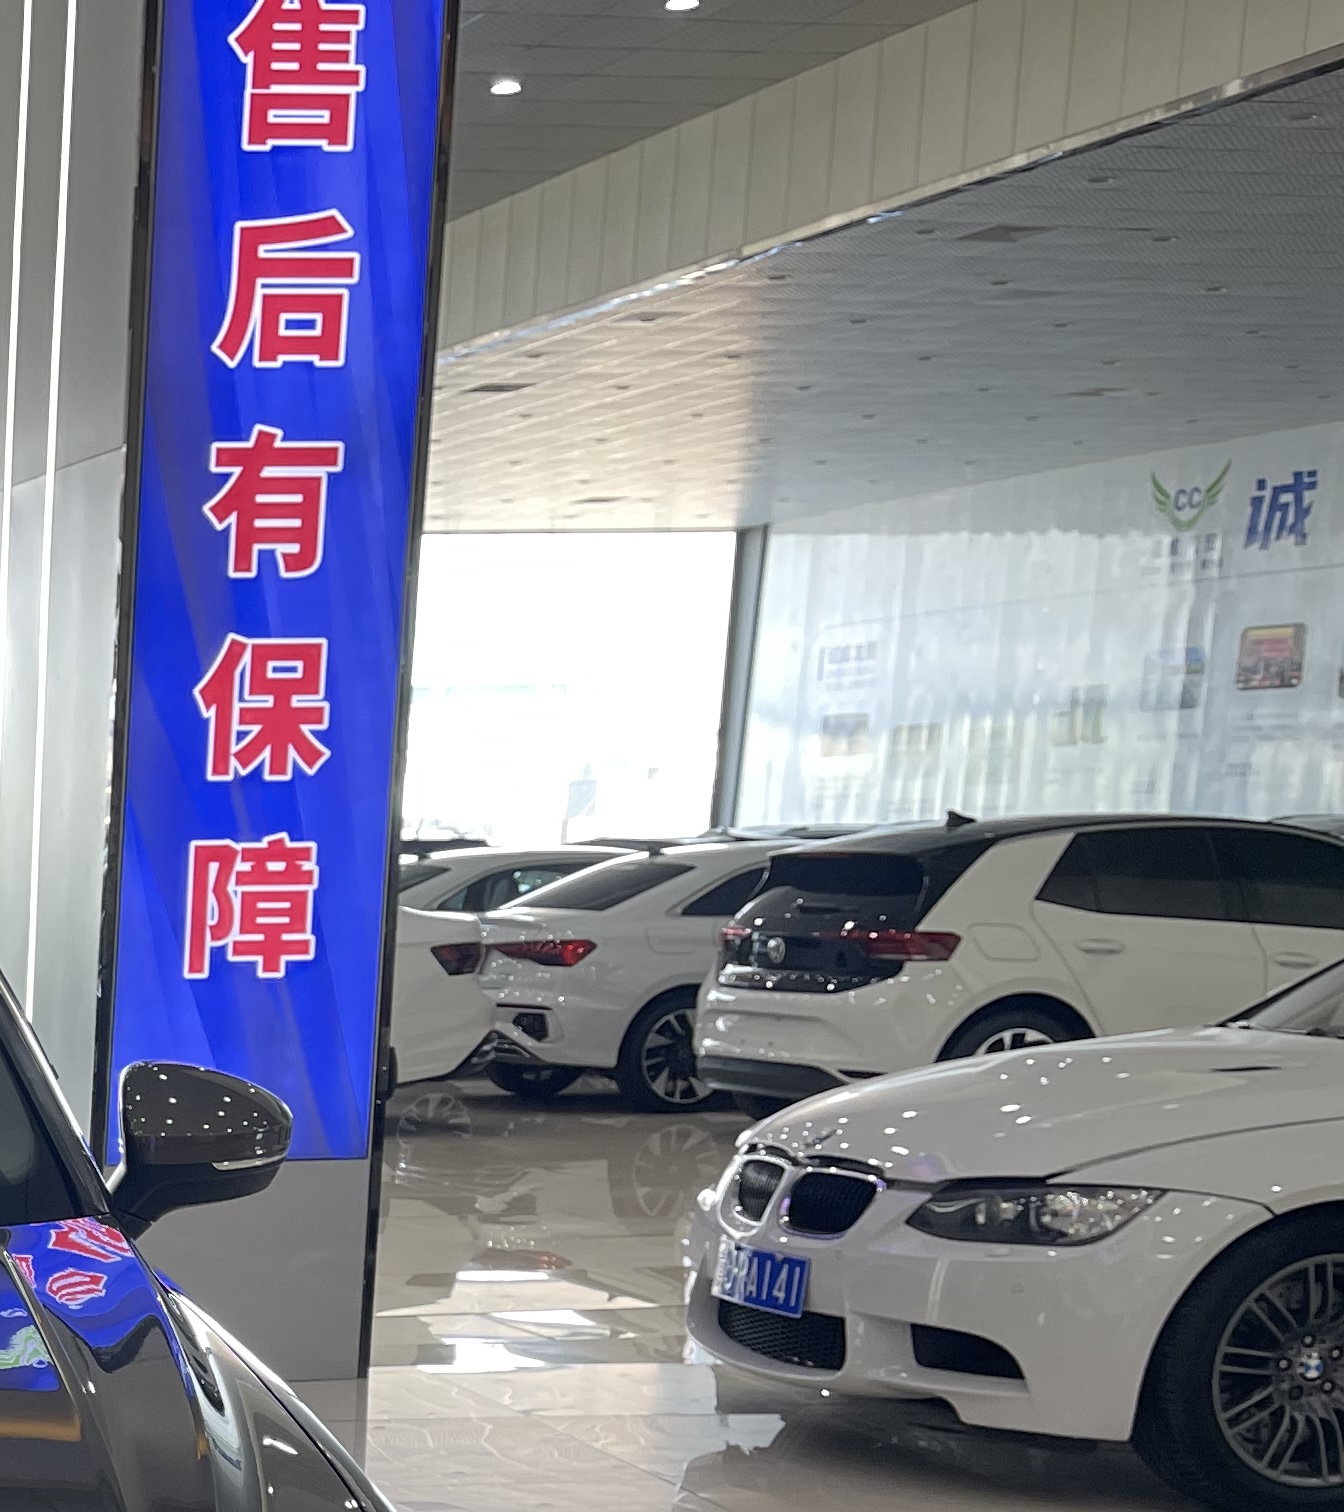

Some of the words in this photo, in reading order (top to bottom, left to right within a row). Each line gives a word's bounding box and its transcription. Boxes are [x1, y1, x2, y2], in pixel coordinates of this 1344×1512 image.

[183, 0, 366, 980] 售后有保障
[1243, 469, 1318, 551] 诚
